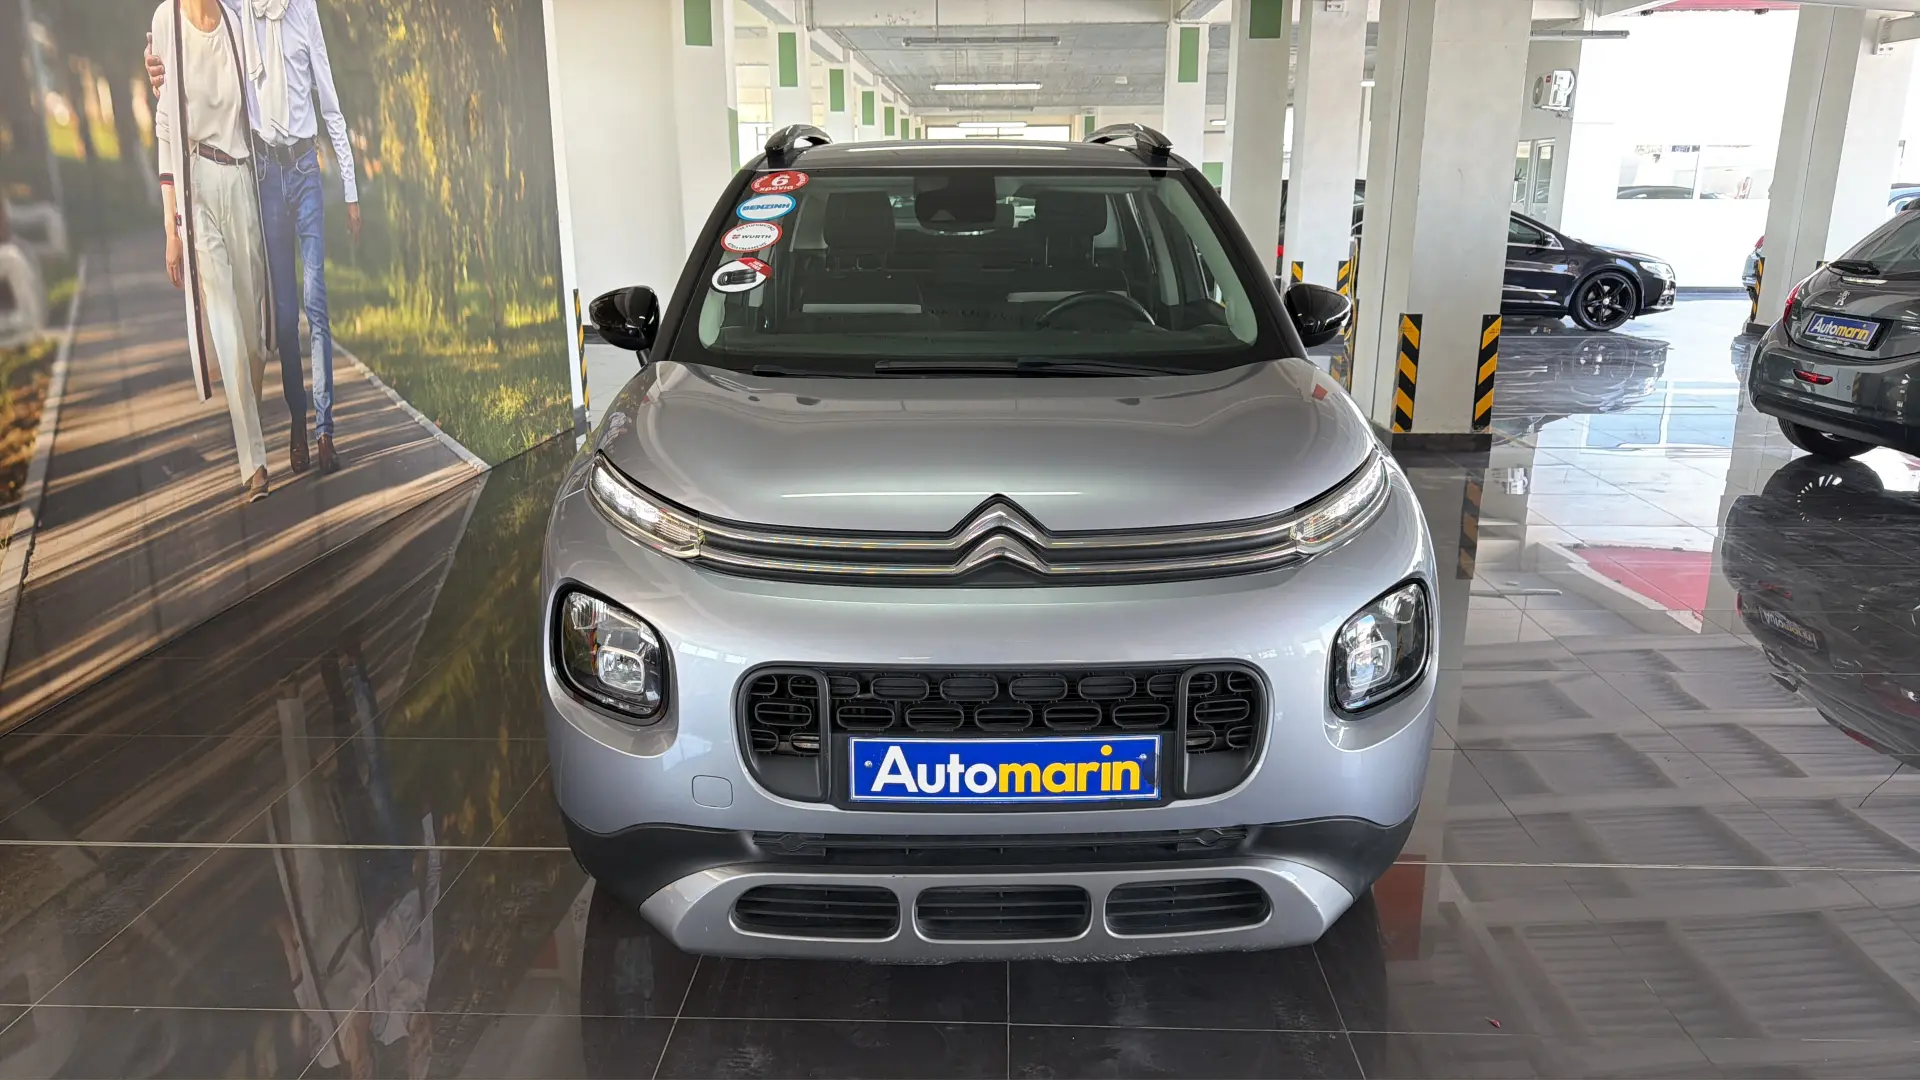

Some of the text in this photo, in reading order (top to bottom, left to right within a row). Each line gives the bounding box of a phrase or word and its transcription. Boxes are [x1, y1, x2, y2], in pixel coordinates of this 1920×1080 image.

[771, 175, 790, 186] 6
[1810, 316, 1870, 340] Automarin
[871, 745, 1140, 794] Automarin
